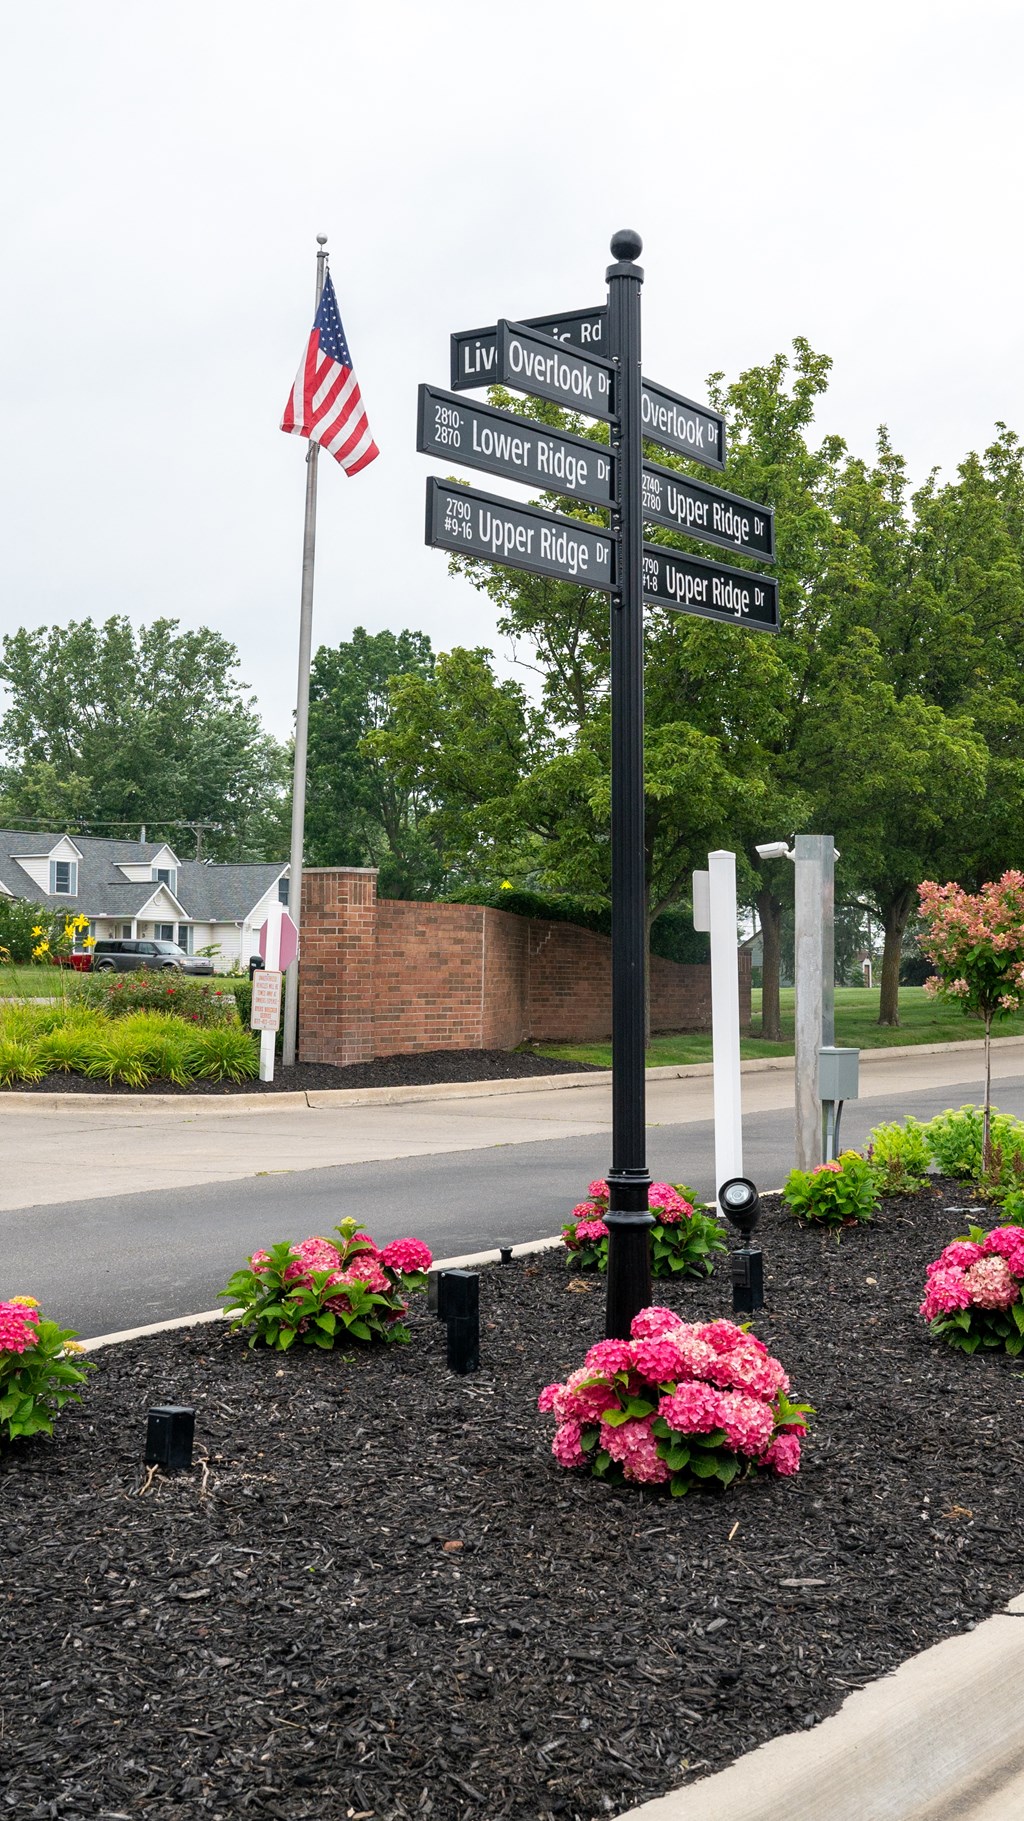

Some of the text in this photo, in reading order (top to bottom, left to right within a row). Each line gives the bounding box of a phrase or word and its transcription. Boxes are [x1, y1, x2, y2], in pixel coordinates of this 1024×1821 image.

[580, 319, 602, 343] Rd
[508, 340, 593, 400] Overlook
[598, 372, 611, 396] Dr
[434, 405, 464, 429] 2810-
[434, 424, 461, 448] 2870
[641, 393, 718, 448] Overlook Dr
[472, 419, 610, 489] Lower Ridge Dr
[445, 497, 471, 520] 2790
[642, 491, 661, 511] 2780
[667, 485, 764, 545] Upper Ridge Dr
[444, 517, 472, 540] #9-16
[478, 509, 609, 575] Upper Ridge Dr
[666, 564, 765, 617] Upper Ridge Dr
